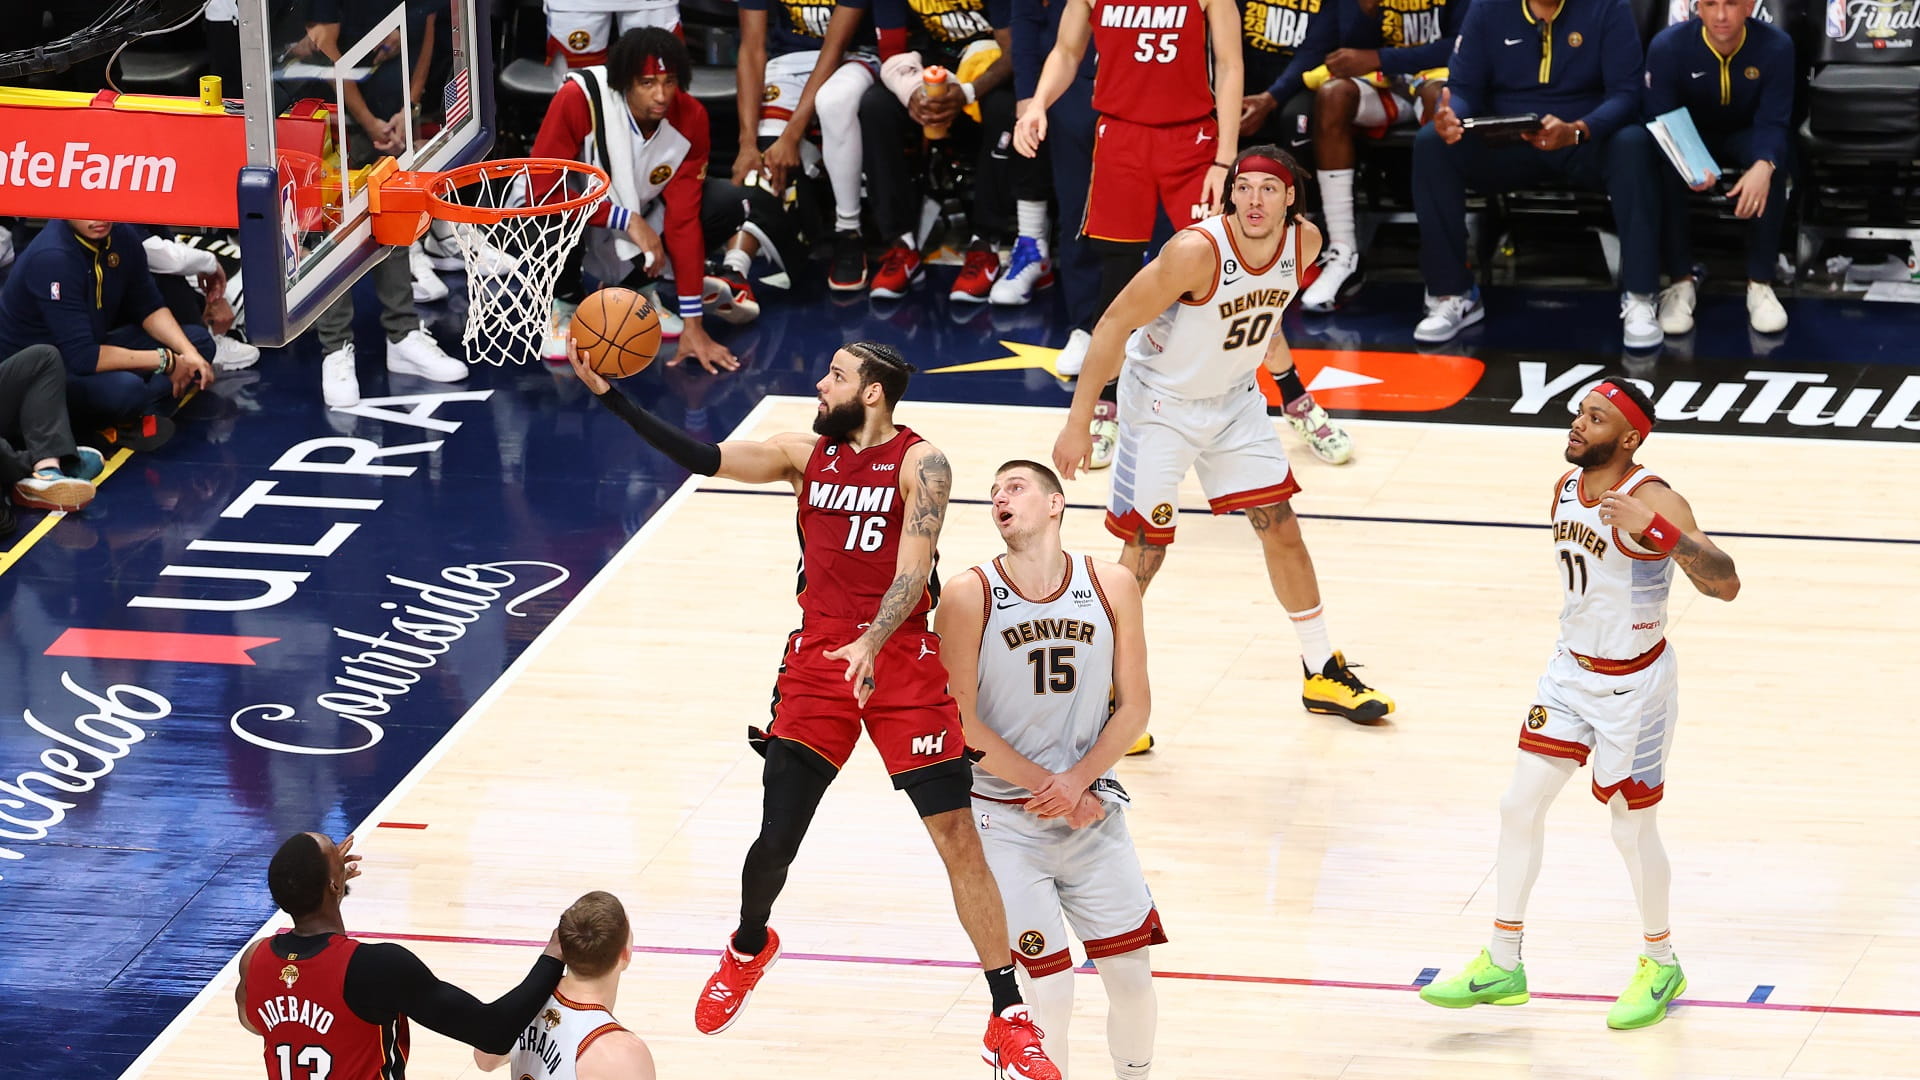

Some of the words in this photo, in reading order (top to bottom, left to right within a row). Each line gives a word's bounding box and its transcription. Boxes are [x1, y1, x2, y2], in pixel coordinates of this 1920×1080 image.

[1101, 4, 1188, 28] MIAMI
[1265, 6, 1309, 48] NBA
[1403, 7, 1442, 47] NBA
[1836, 0, 1920, 42] Final
[1133, 33, 1179, 63] 55
[1226, 260, 1236, 274] 6
[1219, 288, 1291, 320] DENVER
[1223, 312, 1274, 351] 50
[825, 445, 837, 456] 6
[127, 389, 495, 611] ULTRA
[808, 481, 896, 513] MIAMI
[844, 515, 887, 552] 16
[1553, 520, 1609, 561] DENVER
[1560, 549, 1588, 596] 11
[995, 588, 1006, 600] 6
[1071, 589, 1092, 599] WU
[1000, 617, 1096, 652] DENVER
[230, 560, 571, 755] Courtside
[1027, 645, 1077, 695] 15
[257, 996, 335, 1035] ADEBAYO
[519, 1025, 562, 1076] BRAUN
